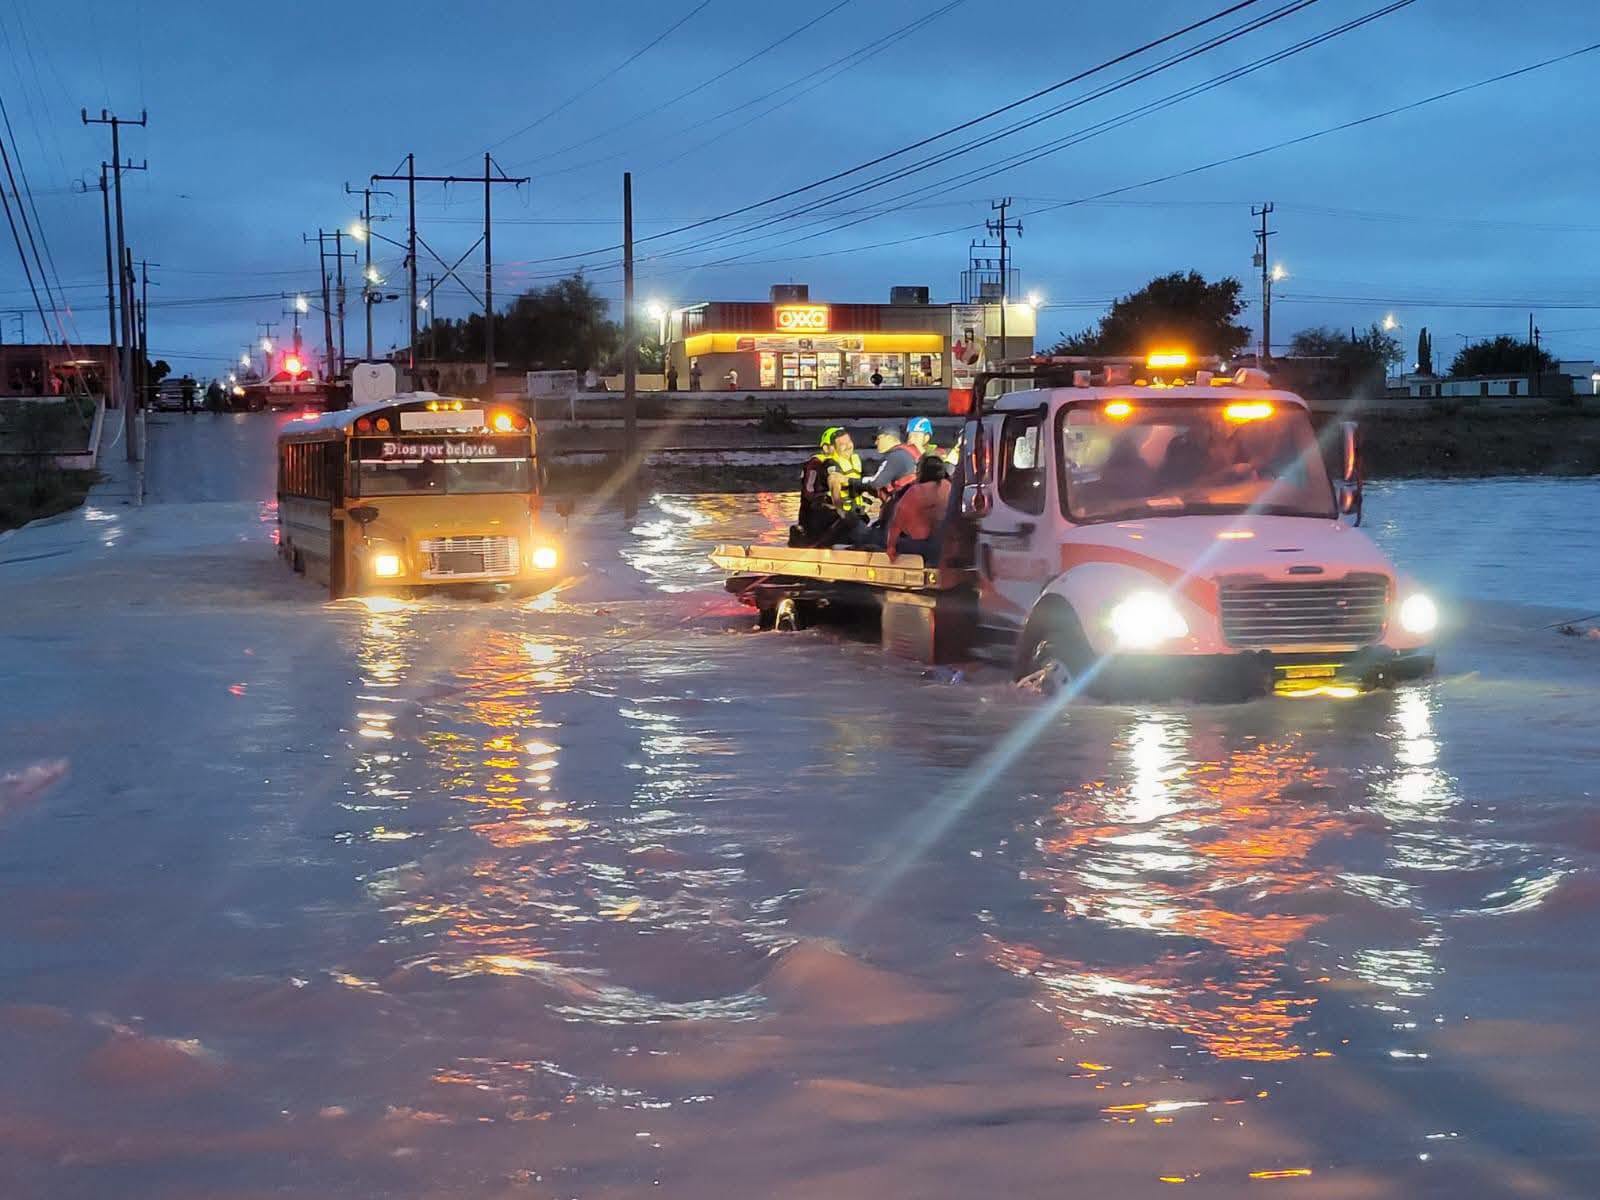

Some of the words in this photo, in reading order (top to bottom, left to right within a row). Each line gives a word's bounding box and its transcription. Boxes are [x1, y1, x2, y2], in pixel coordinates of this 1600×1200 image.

[779, 310, 825, 328] OXXO
[384, 443, 417, 455] Dios
[421, 445, 444, 457] por
